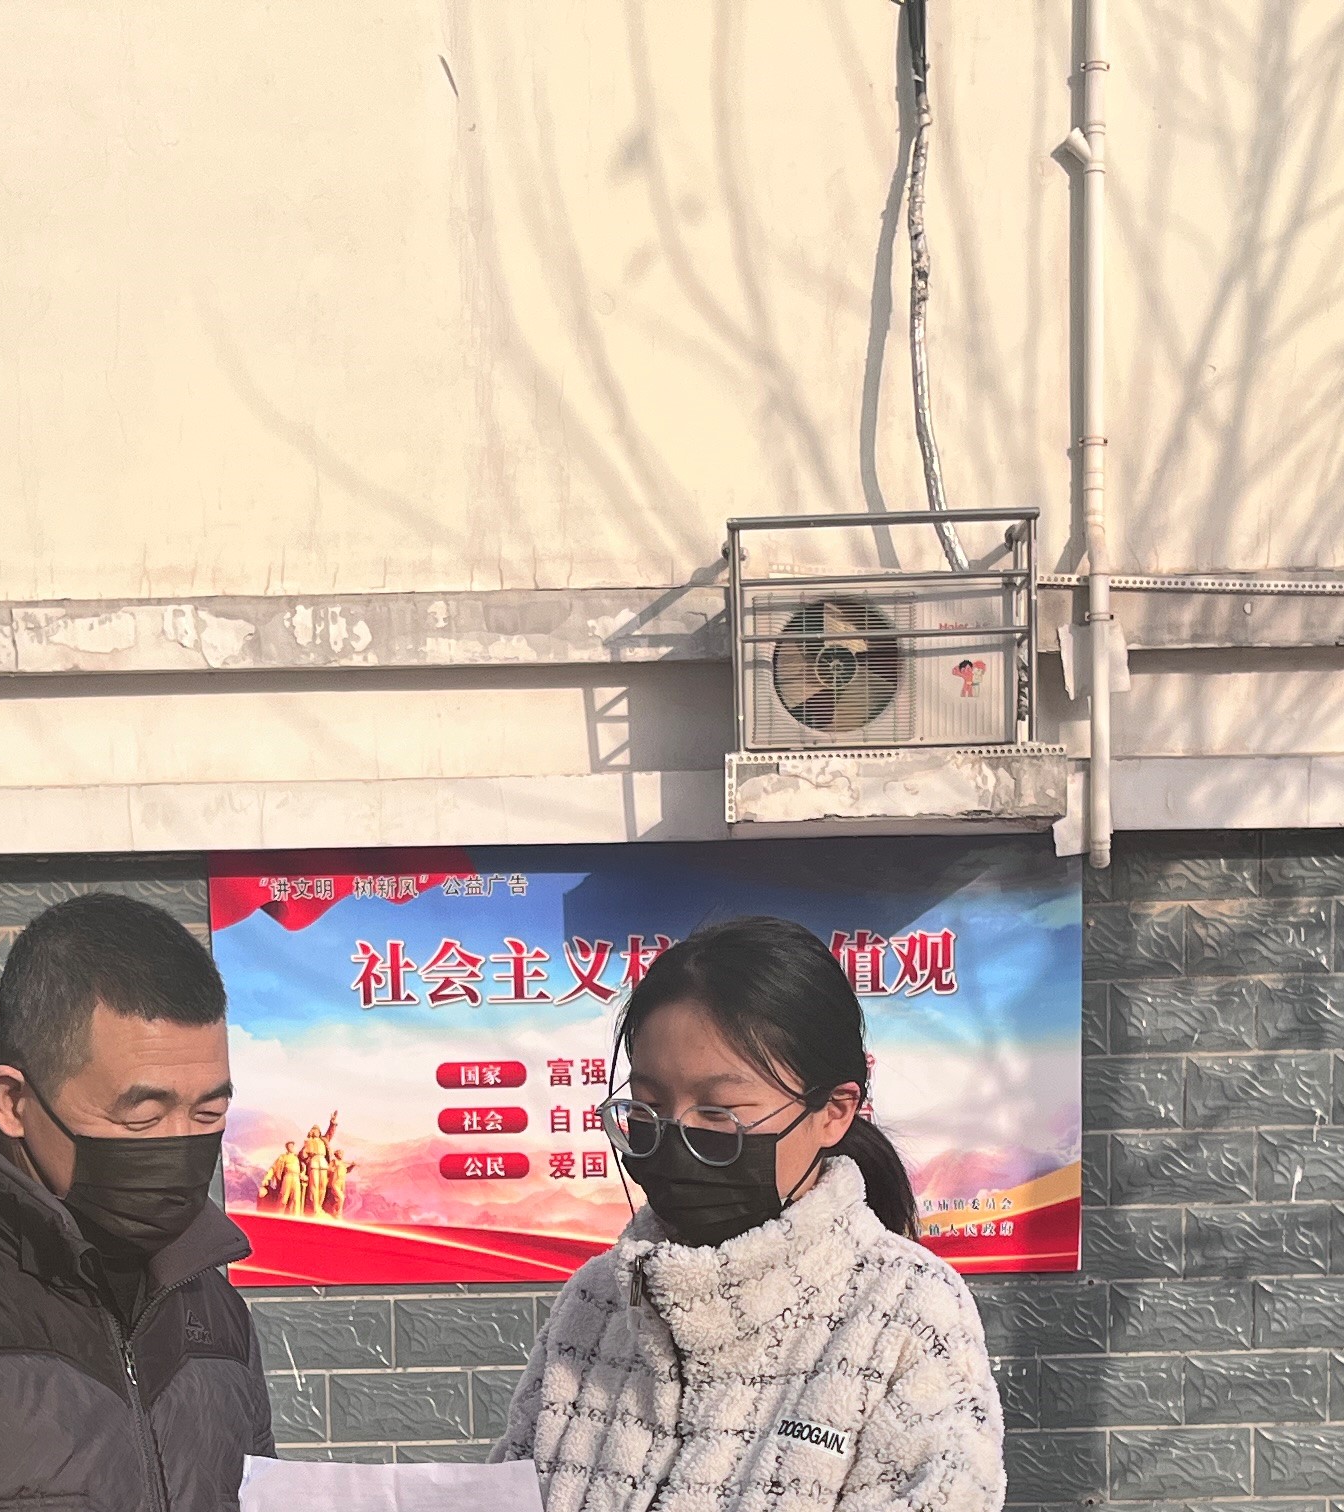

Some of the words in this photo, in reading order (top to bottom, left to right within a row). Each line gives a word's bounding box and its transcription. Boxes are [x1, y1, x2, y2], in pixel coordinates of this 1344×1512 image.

[442, 873, 528, 897] 公益广告
[459, 1065, 502, 1086] 国家
[546, 1057, 608, 1087] 富强
[462, 1110, 504, 1132] 社会
[550, 1104, 605, 1134] 自由
[463, 1156, 506, 1177] 公民
[548, 1150, 608, 1180] 爱国
